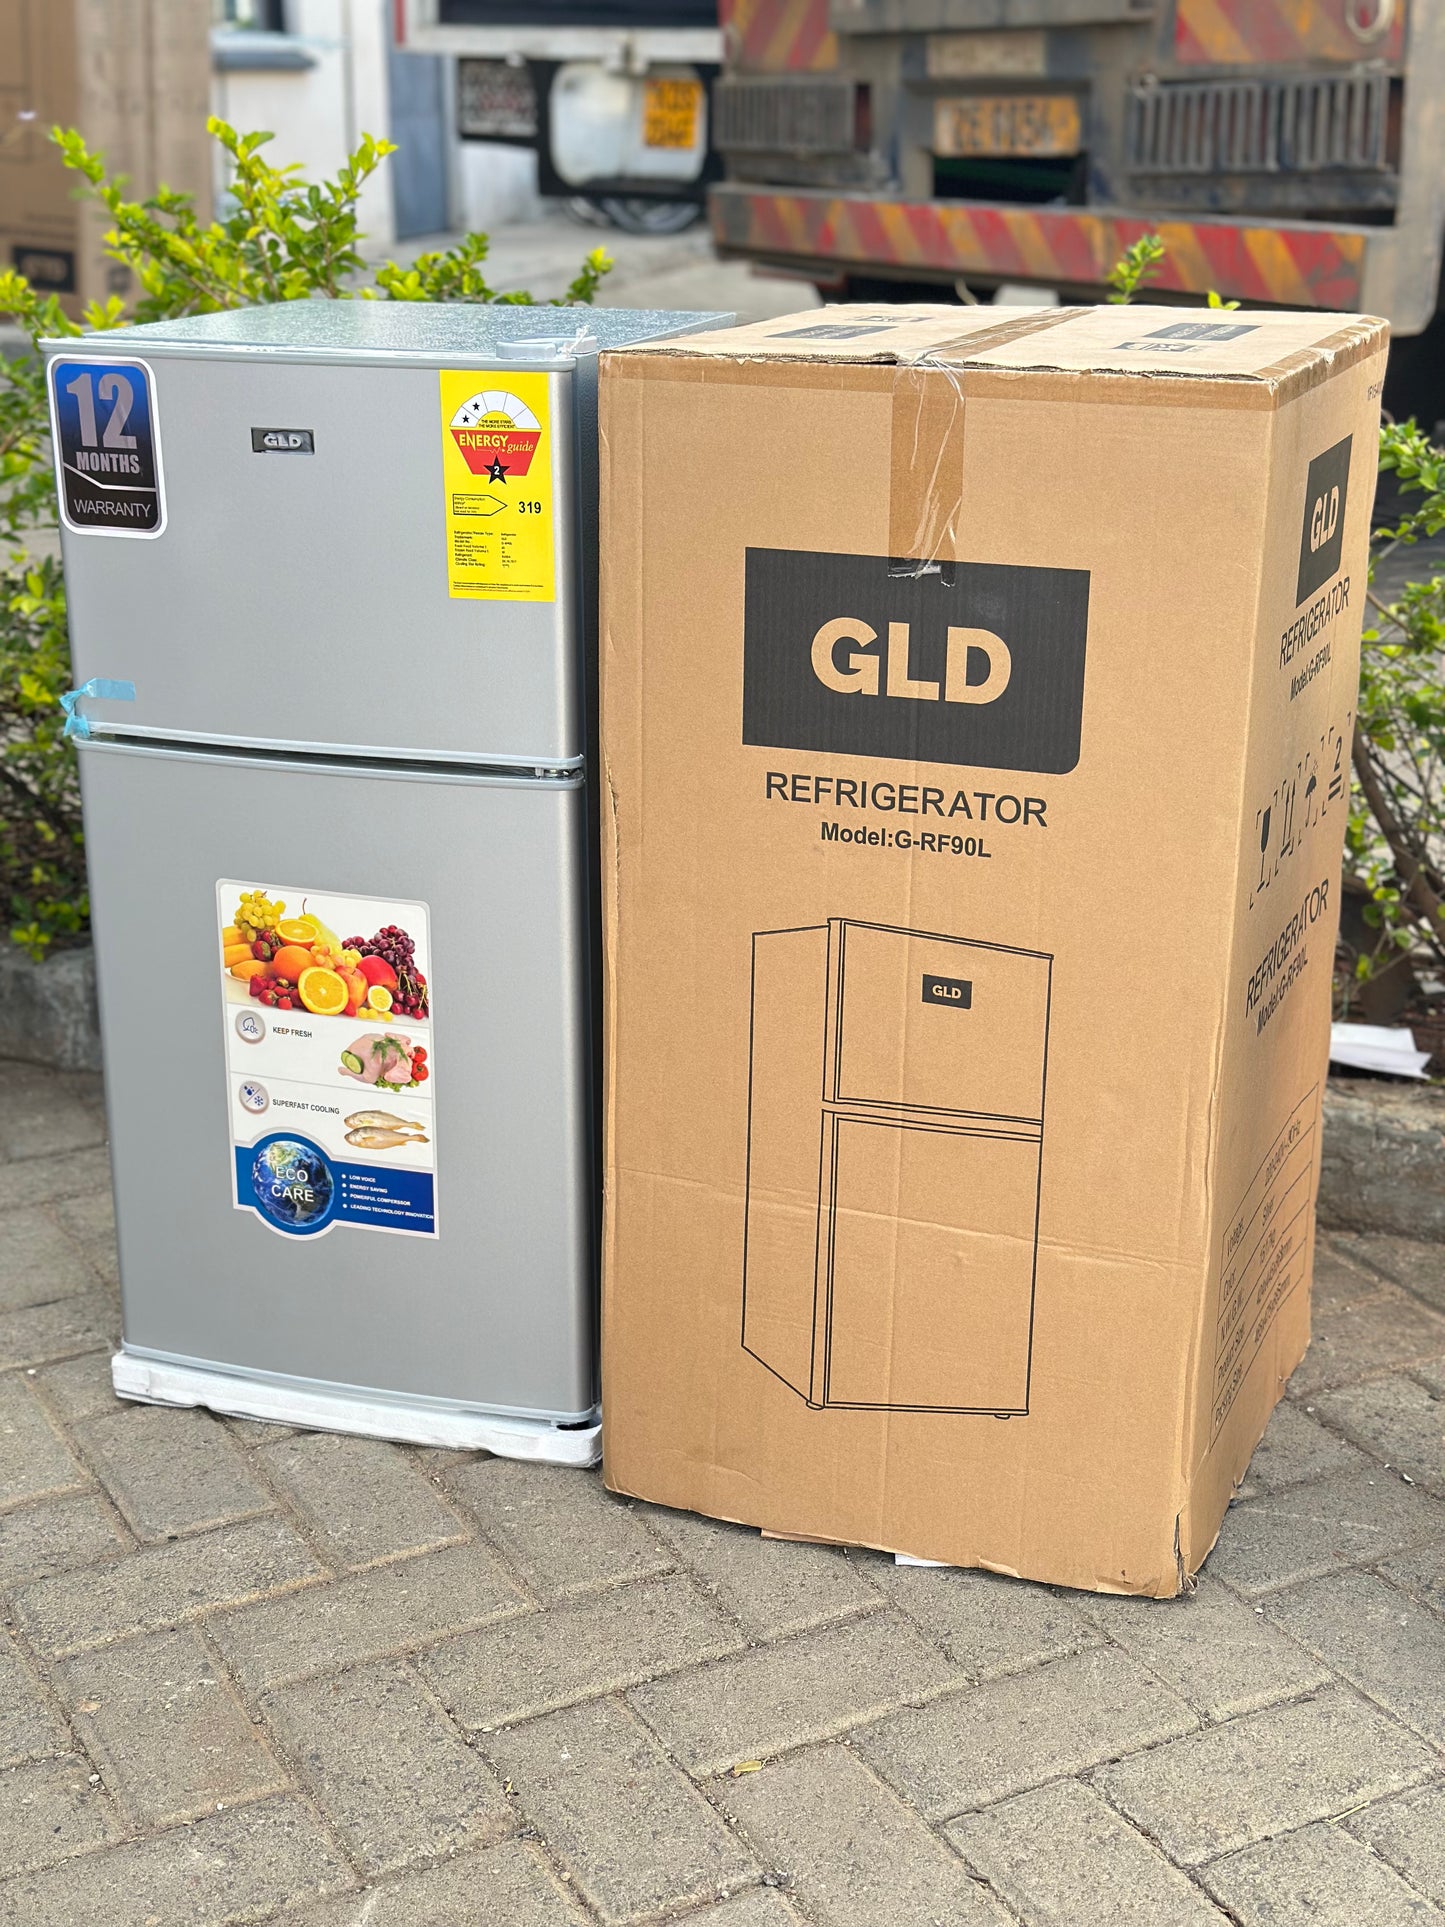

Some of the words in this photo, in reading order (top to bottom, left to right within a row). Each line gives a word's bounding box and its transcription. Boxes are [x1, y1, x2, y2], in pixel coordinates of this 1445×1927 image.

[66, 373, 137, 449] 12
[264, 432, 302, 448] GLD
[459, 431, 509, 452] ENERGY
[506, 440, 534, 454] guide
[75, 451, 140, 474] MONTHS
[494, 466, 500, 475] 2
[74, 499, 151, 518] WARRANTY
[518, 501, 541, 514] 319
[1310, 485, 1340, 553] GLD
[1279, 576, 1350, 670] REFRIGERATOR
[811, 617, 1012, 705] GLD
[766, 771, 1048, 827] REFRIGERATOR
[821, 822, 992, 858] Model:G-RF90L
[1245, 878, 1329, 1019] REFRIGERATOR
[932, 984, 962, 999] GLD
[272, 1026, 290, 1035] KEEP
[290, 1029, 313, 1038] FRESH
[272, 1099, 309, 1110] SUPERFAST
[310, 1104, 340, 1115] COOLING
[275, 1166, 309, 1183] ECO
[271, 1184, 314, 1203] CARE
[349, 1193, 376, 1202] POWERFUL
[370, 1186, 388, 1194] SAVING
[371, 1206, 405, 1216] TECHNOLOGY
